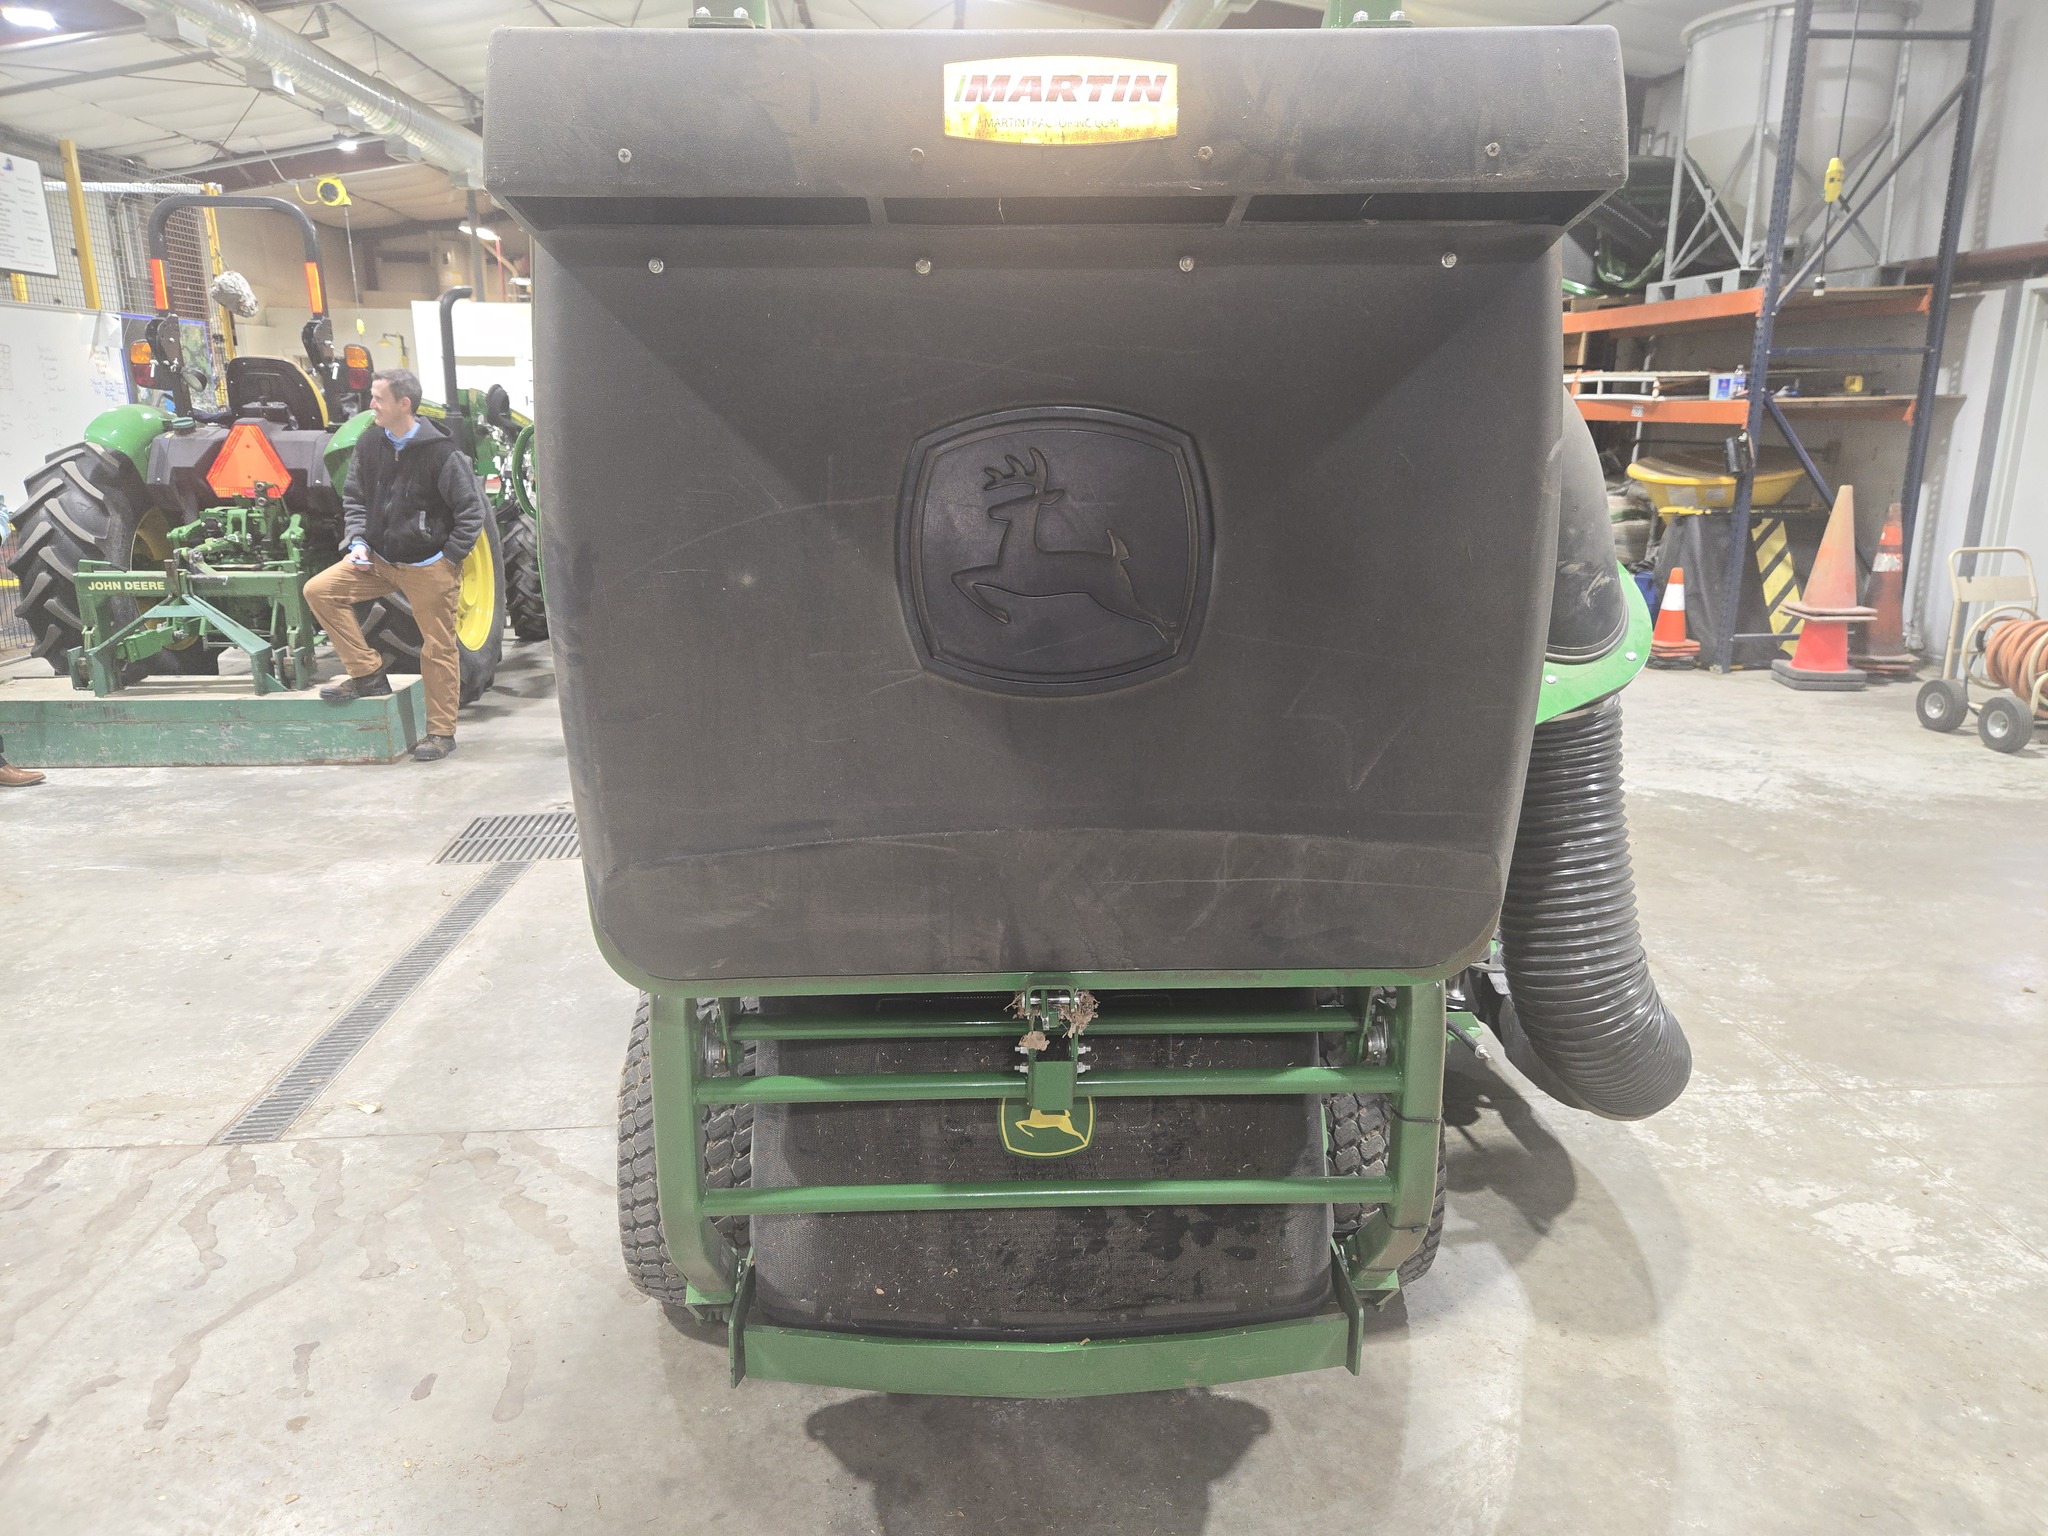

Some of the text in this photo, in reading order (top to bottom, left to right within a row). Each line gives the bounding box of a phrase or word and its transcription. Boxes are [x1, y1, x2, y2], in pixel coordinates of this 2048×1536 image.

[964, 75, 1168, 102] MARTIN
[984, 117, 1120, 128] MARTINTRACORINC.COM
[88, 581, 165, 590] JOHN DEERE
